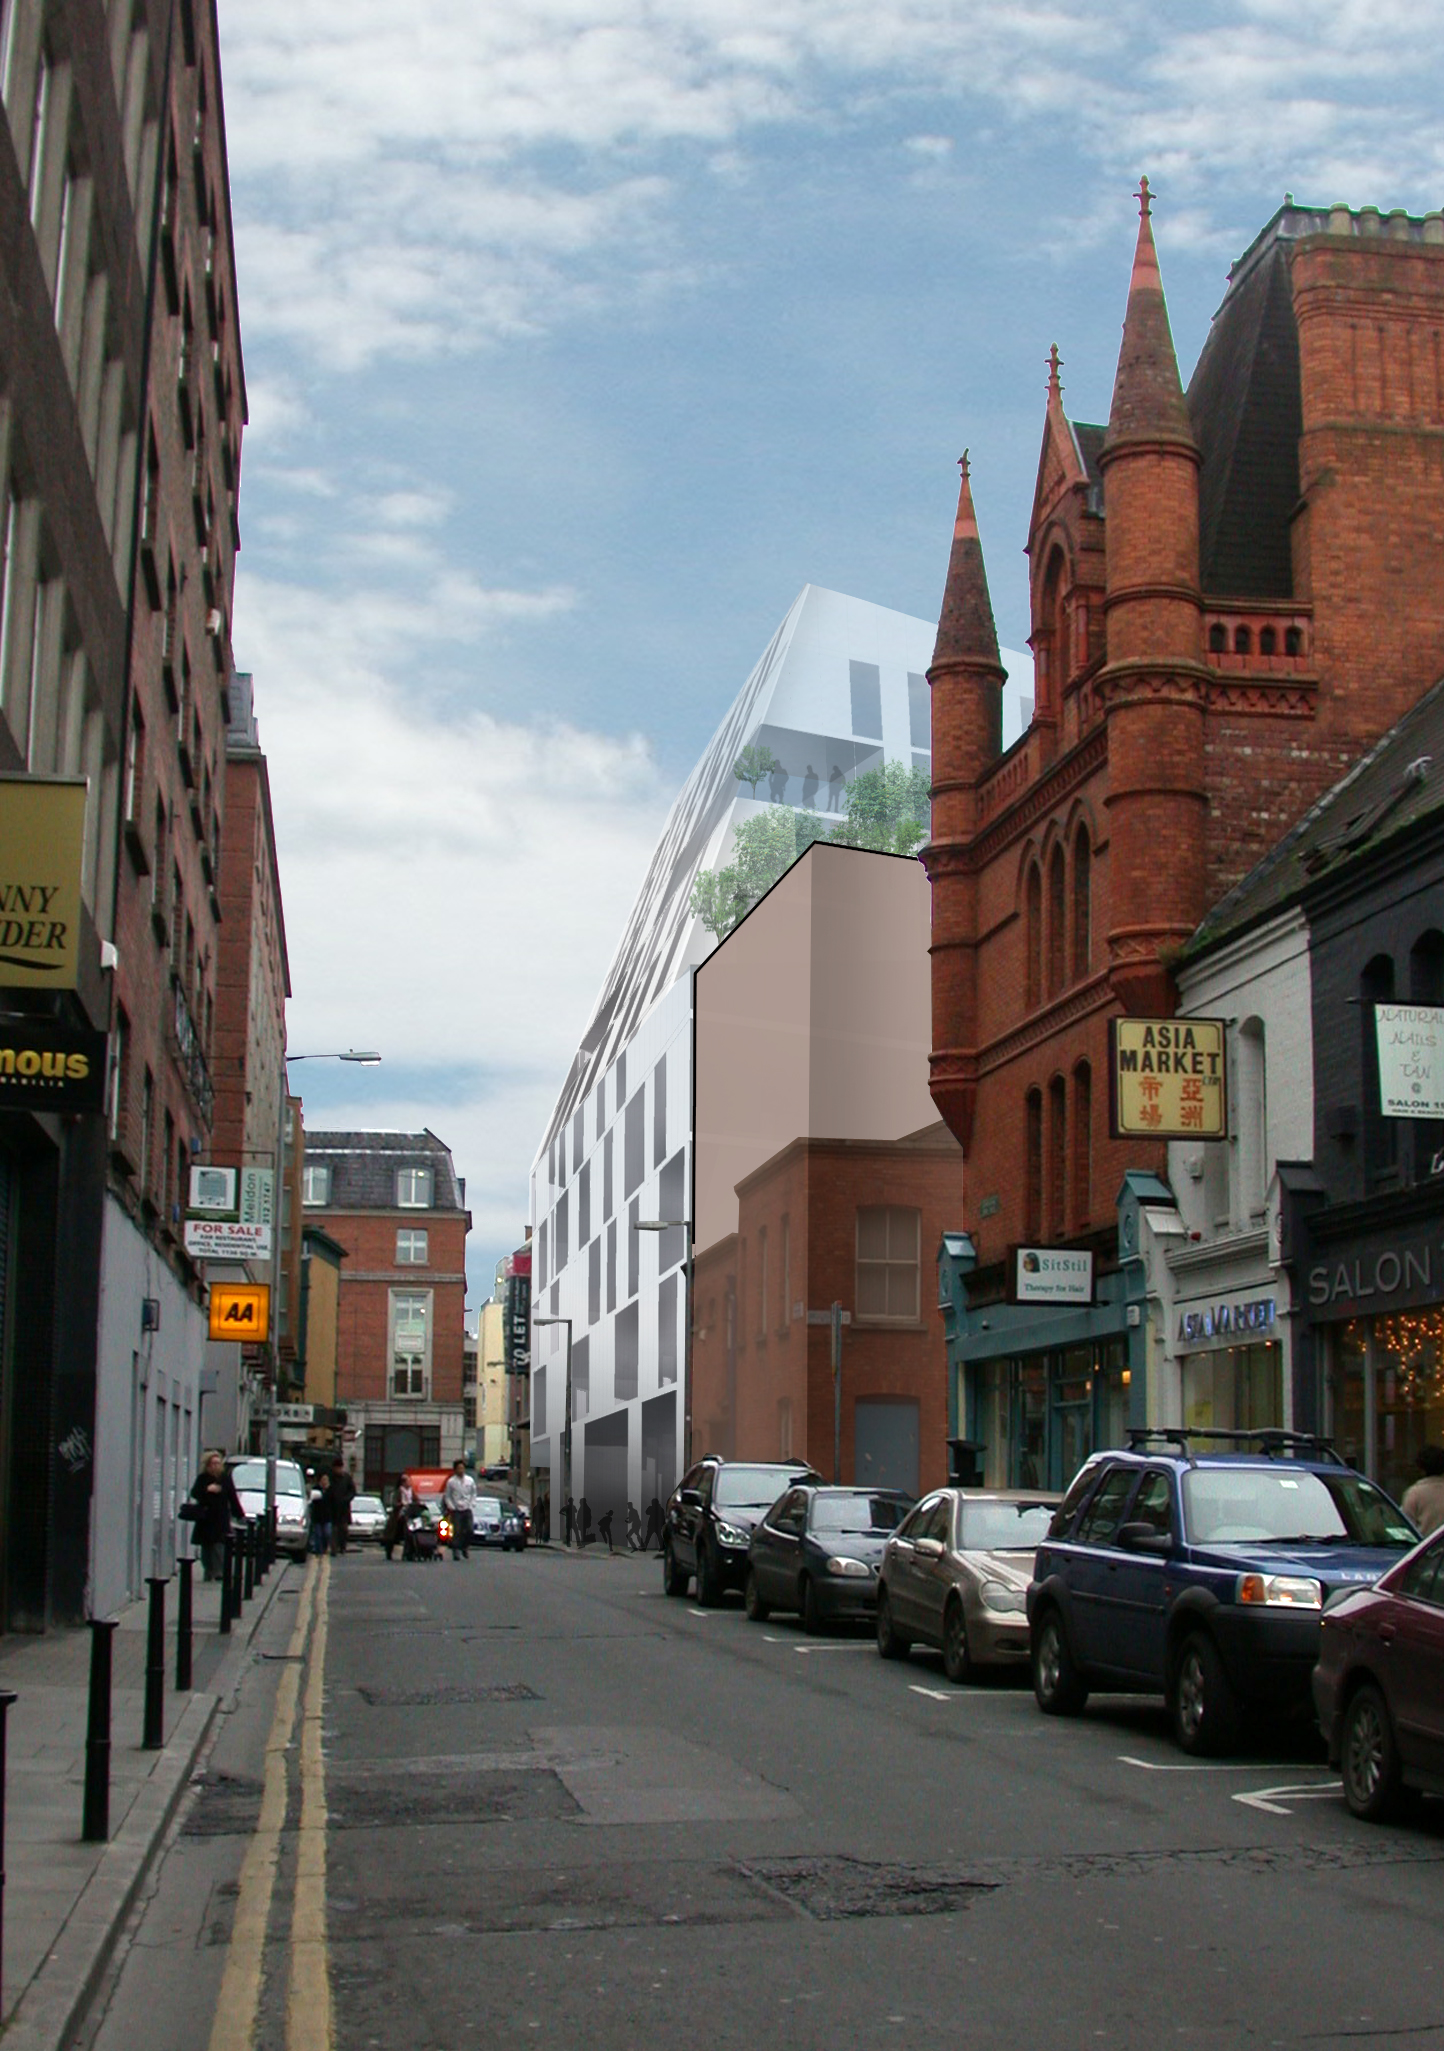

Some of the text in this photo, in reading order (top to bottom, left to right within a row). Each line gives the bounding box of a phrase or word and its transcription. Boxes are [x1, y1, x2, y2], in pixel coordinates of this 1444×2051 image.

[1142, 1025, 1196, 1050] ASIA
[1389, 1031, 1437, 1047] NAILS
[1119, 1049, 1220, 1075] MARKET
[1400, 1063, 1431, 1079] TAN
[1387, 1099, 1429, 1109] SALON
[193, 1223, 263, 1237] FOR SALE
[1042, 1258, 1087, 1273] SitStil
[1309, 1245, 1431, 1305] SALON
[224, 1302, 253, 1323] AA
[513, 1315, 527, 1344] LET
